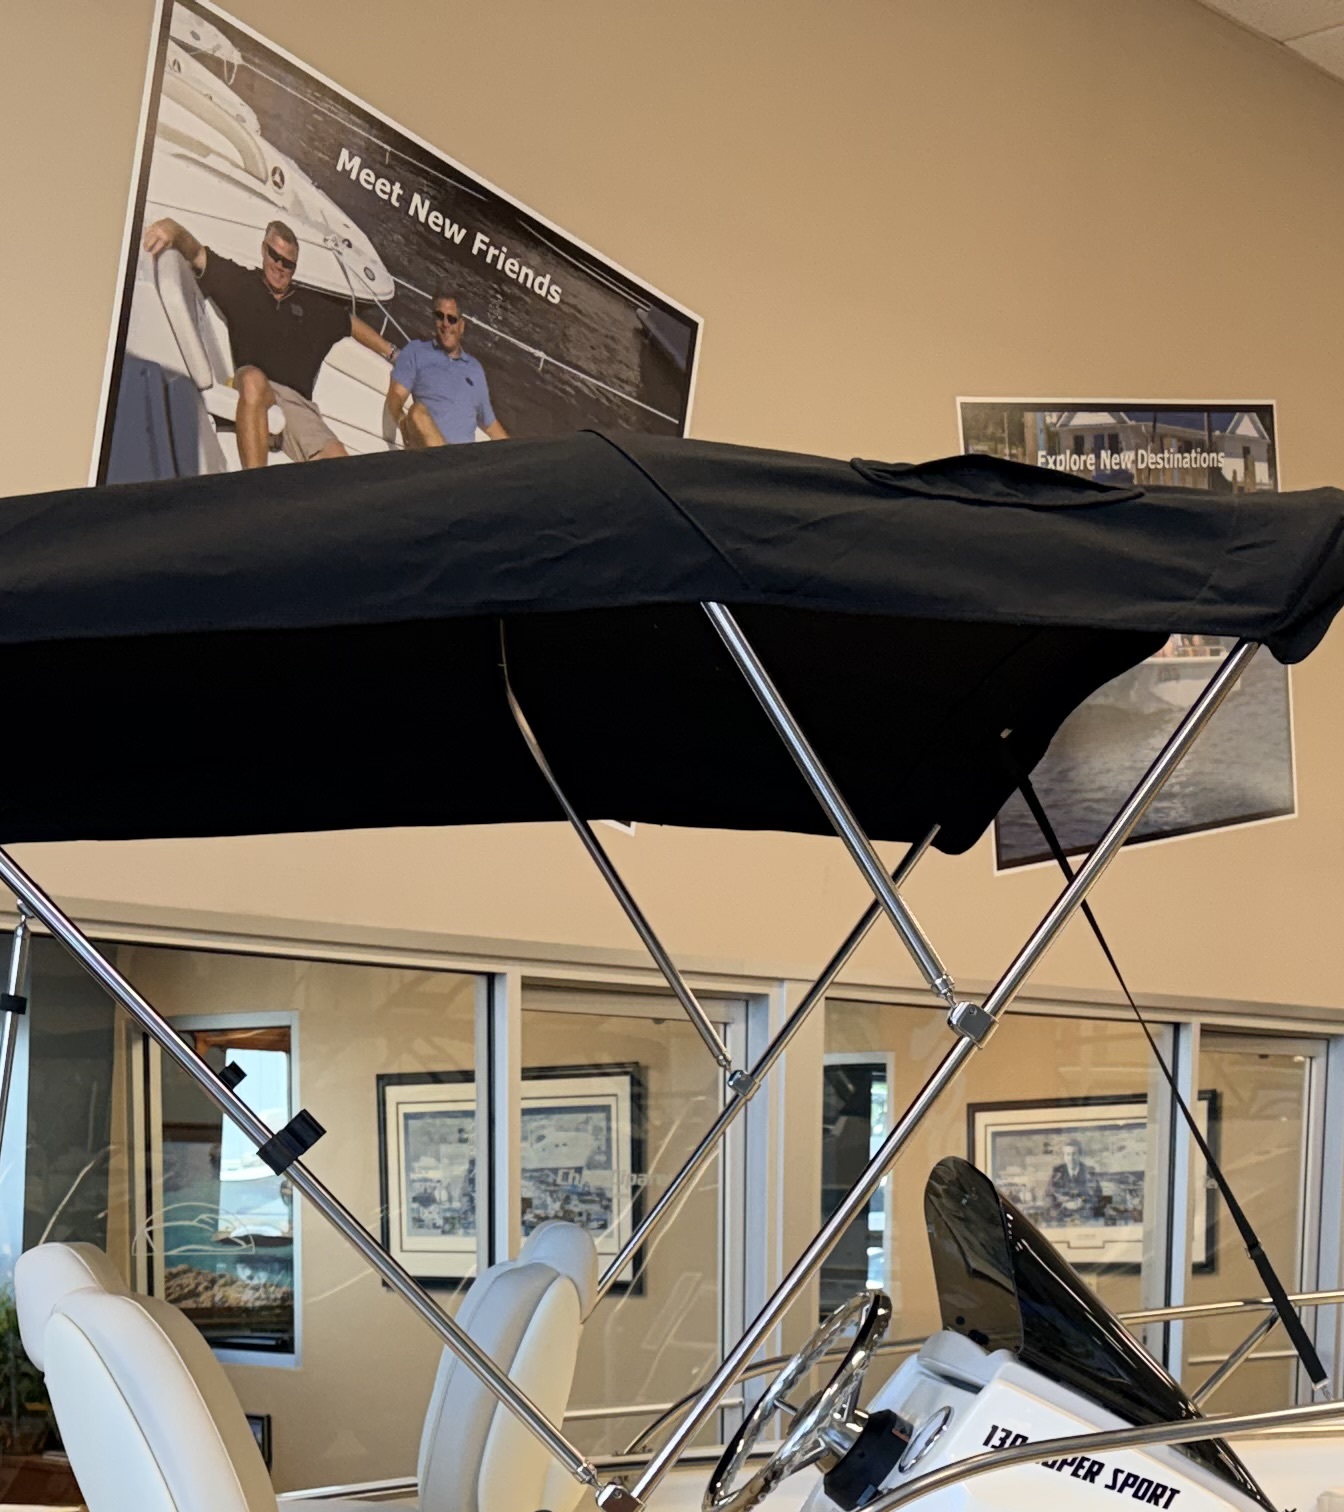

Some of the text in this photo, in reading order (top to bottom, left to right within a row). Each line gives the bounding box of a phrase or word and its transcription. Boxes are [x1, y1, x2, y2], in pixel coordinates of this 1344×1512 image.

[336, 148, 563, 305] Meet New Friends
[1037, 448, 1225, 471] Explore New Destinations
[1035, 1456, 1181, 1510] PER SPORT
